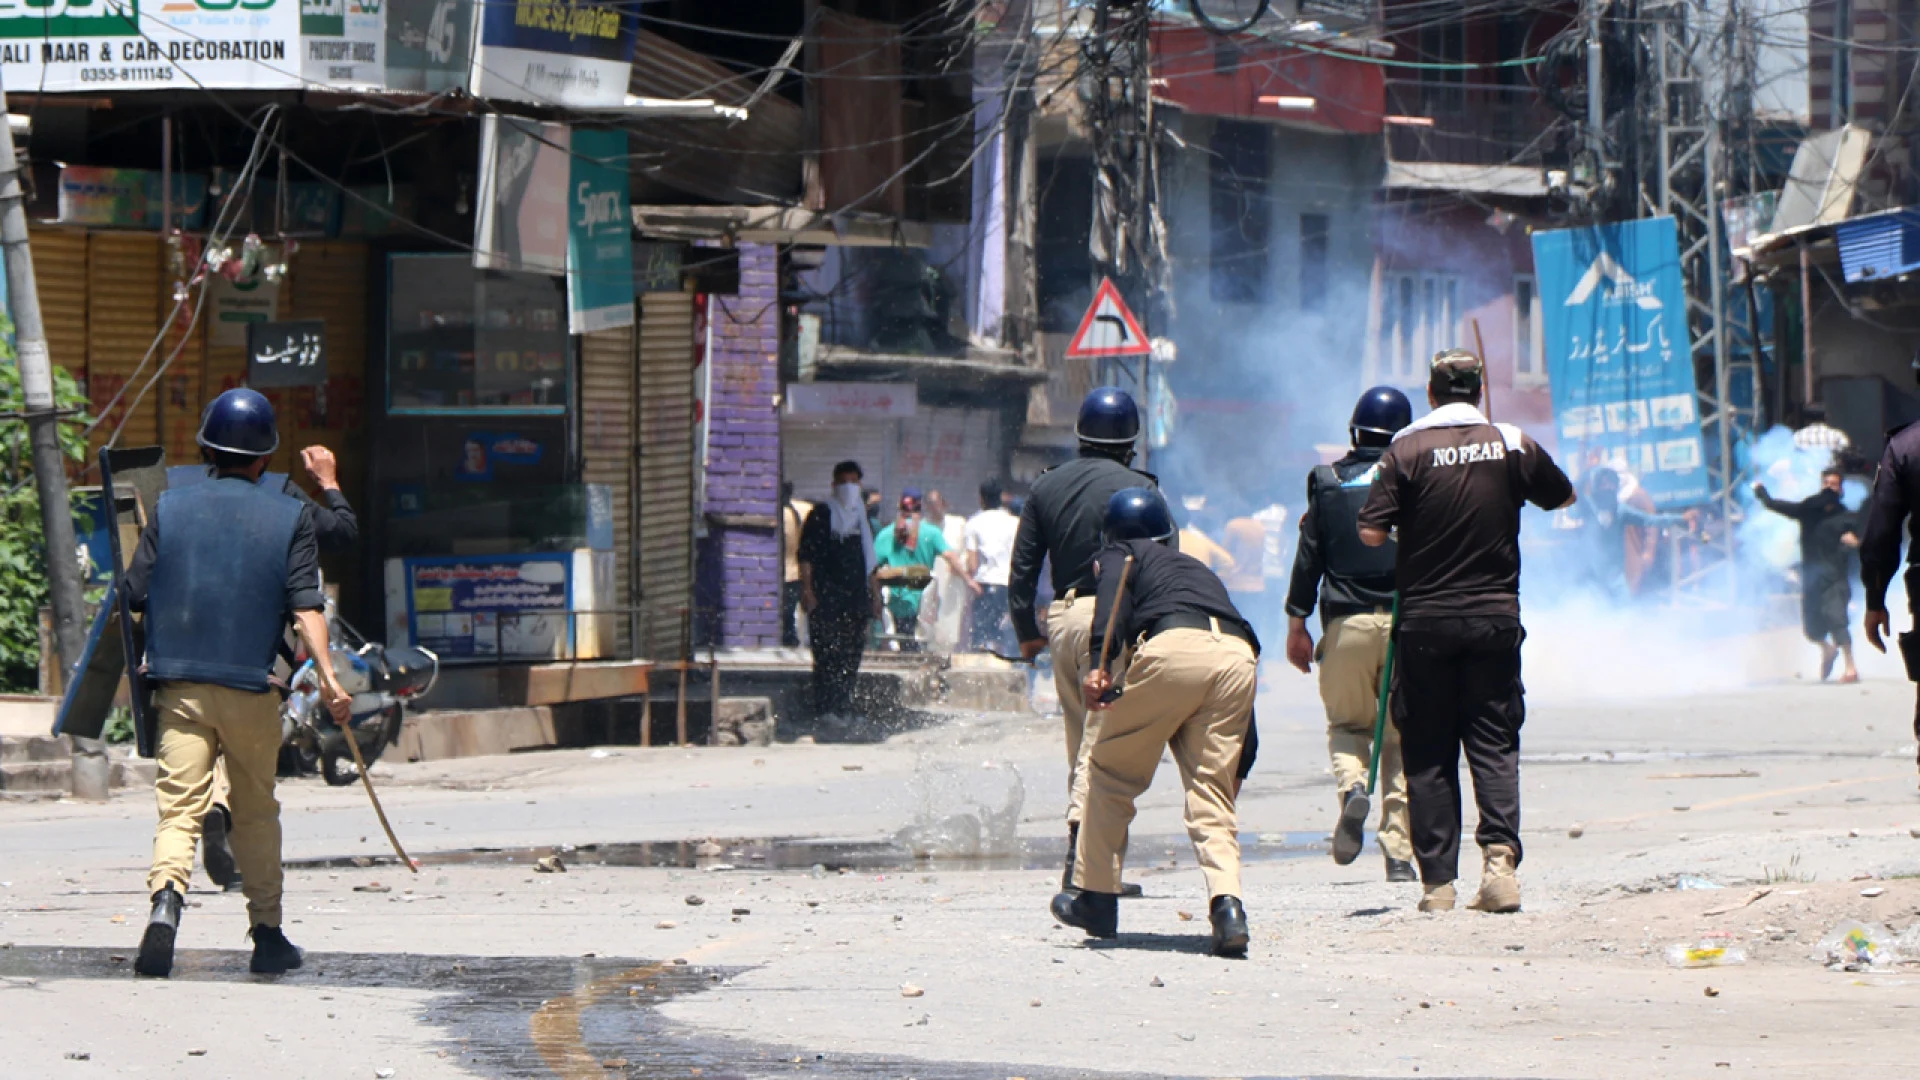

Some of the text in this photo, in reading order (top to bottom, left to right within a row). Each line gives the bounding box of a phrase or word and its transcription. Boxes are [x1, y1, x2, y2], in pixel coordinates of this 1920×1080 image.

[0, 44, 30, 63] ALI
[99, 41, 112, 62] &
[122, 41, 159, 61] CAR
[170, 40, 285, 61] DECORATION
[81, 66, 173, 81] 0355-8111145
[577, 180, 623, 237] Sparx
[1432, 441, 1505, 467] NO FEAR
